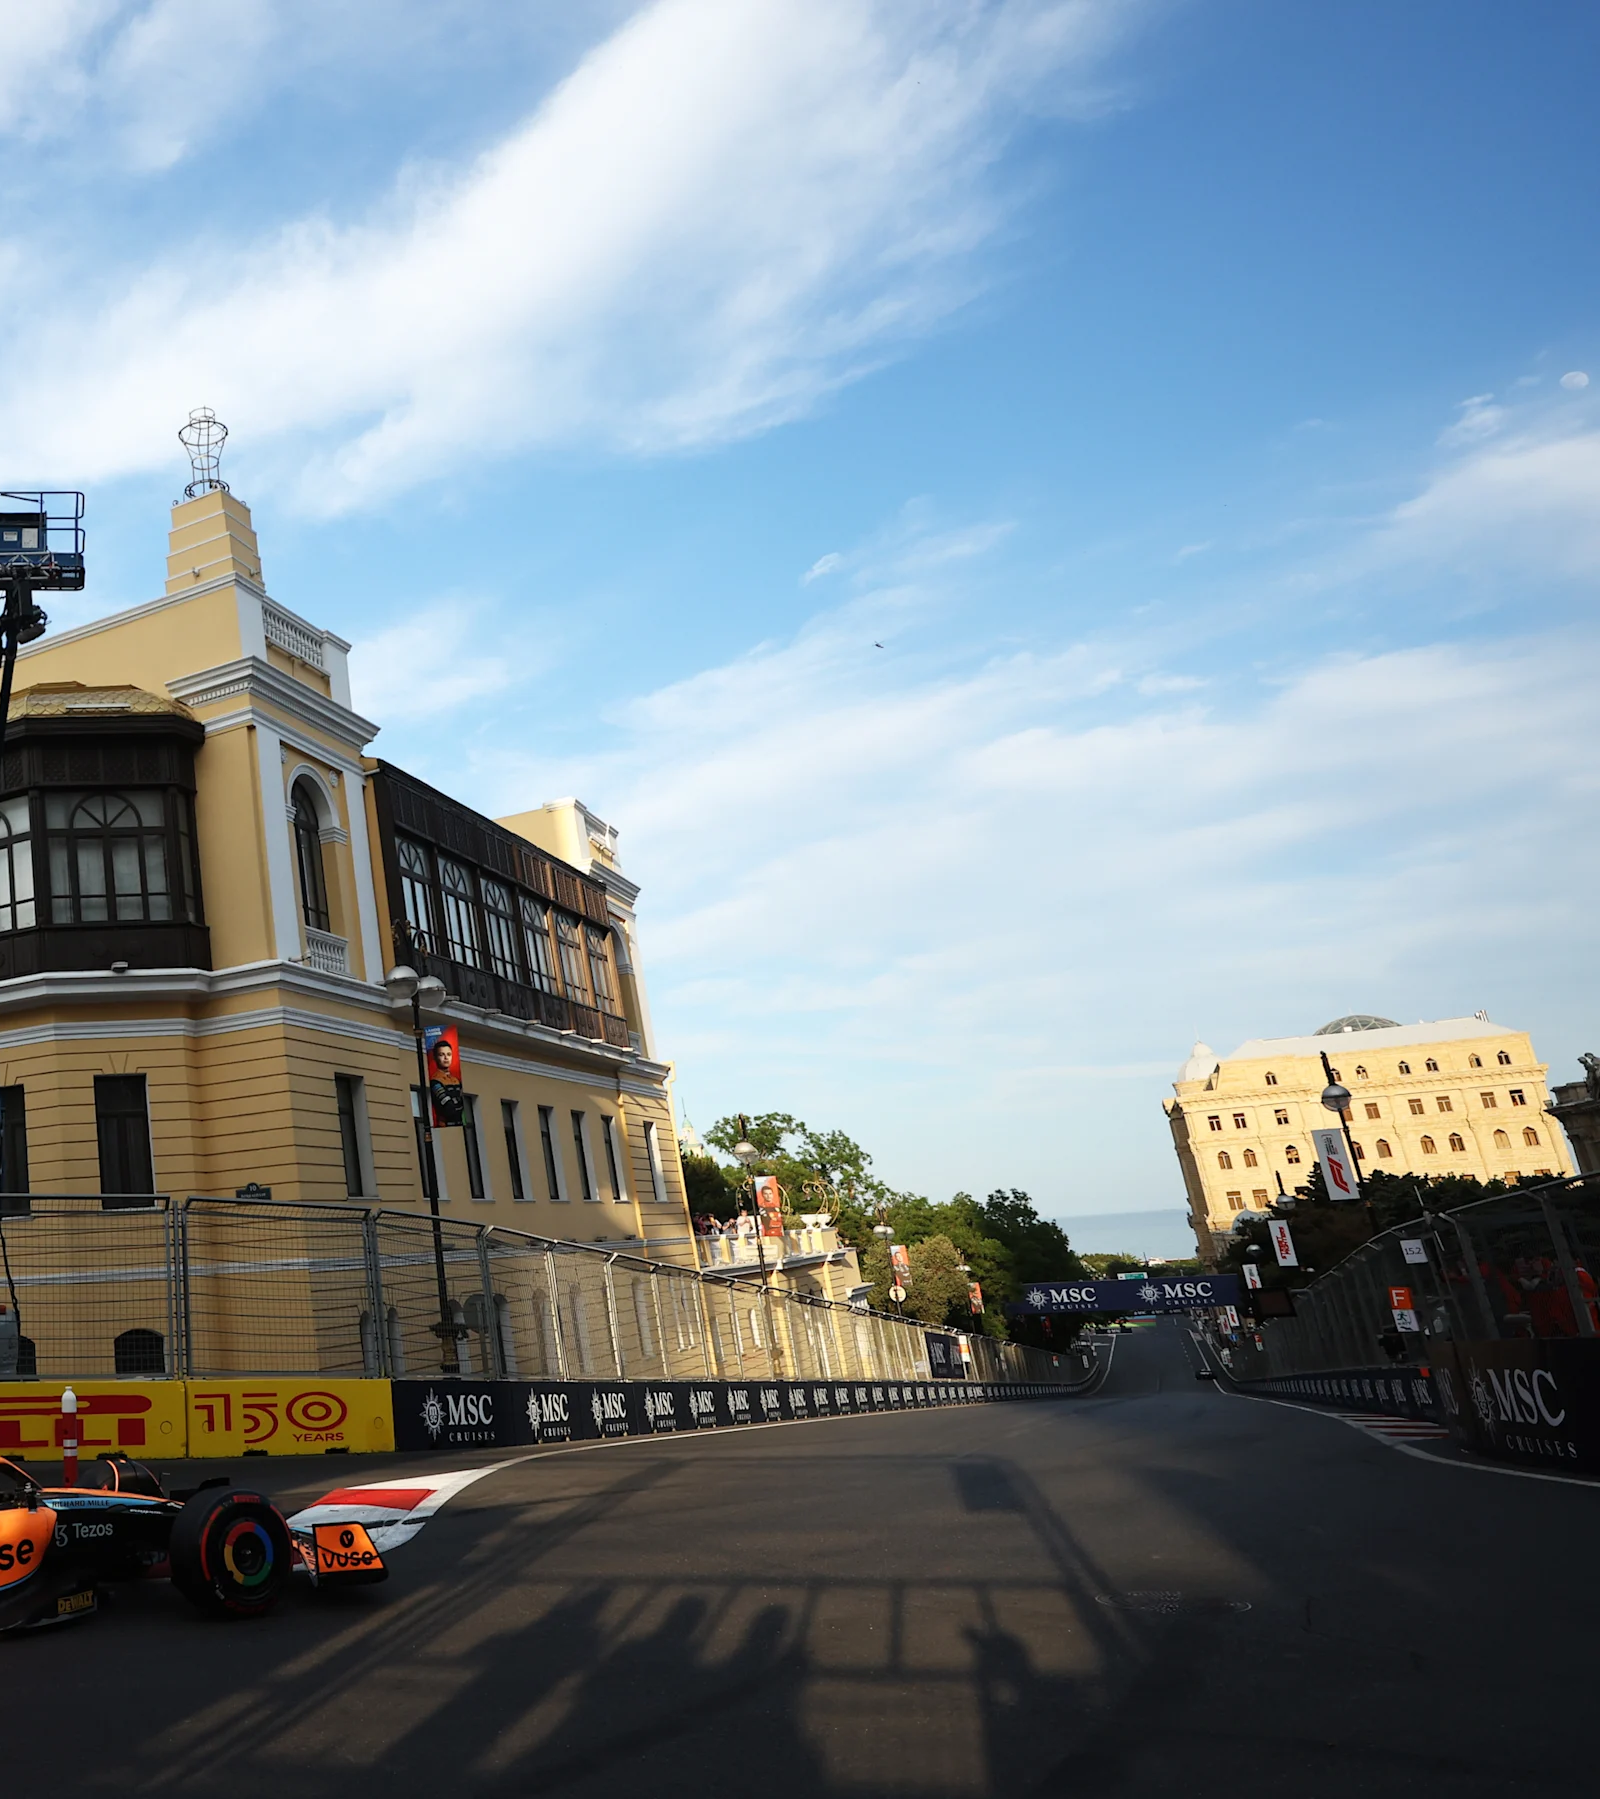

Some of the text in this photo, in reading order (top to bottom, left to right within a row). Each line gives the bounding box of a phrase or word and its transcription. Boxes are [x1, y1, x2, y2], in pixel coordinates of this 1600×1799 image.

[1049, 1287, 1097, 1303] MSC
[1162, 1281, 1214, 1299] MSC
[1392, 1290, 1405, 1306] F
[540, 1393, 570, 1422] MSC
[602, 1392, 627, 1419] MSC
[653, 1391, 675, 1416] MSC
[696, 1390, 716, 1413] MSC
[1487, 1368, 1566, 1427] MSC
[446, 1394, 494, 1426] MSC
[292, 1432, 344, 1442] YEARS
[449, 1431, 496, 1443] CRUISES
[1506, 1433, 1579, 1459] CRUISES
[52, 1500, 86, 1508] RICHARD
[72, 1522, 114, 1539] Tezos
